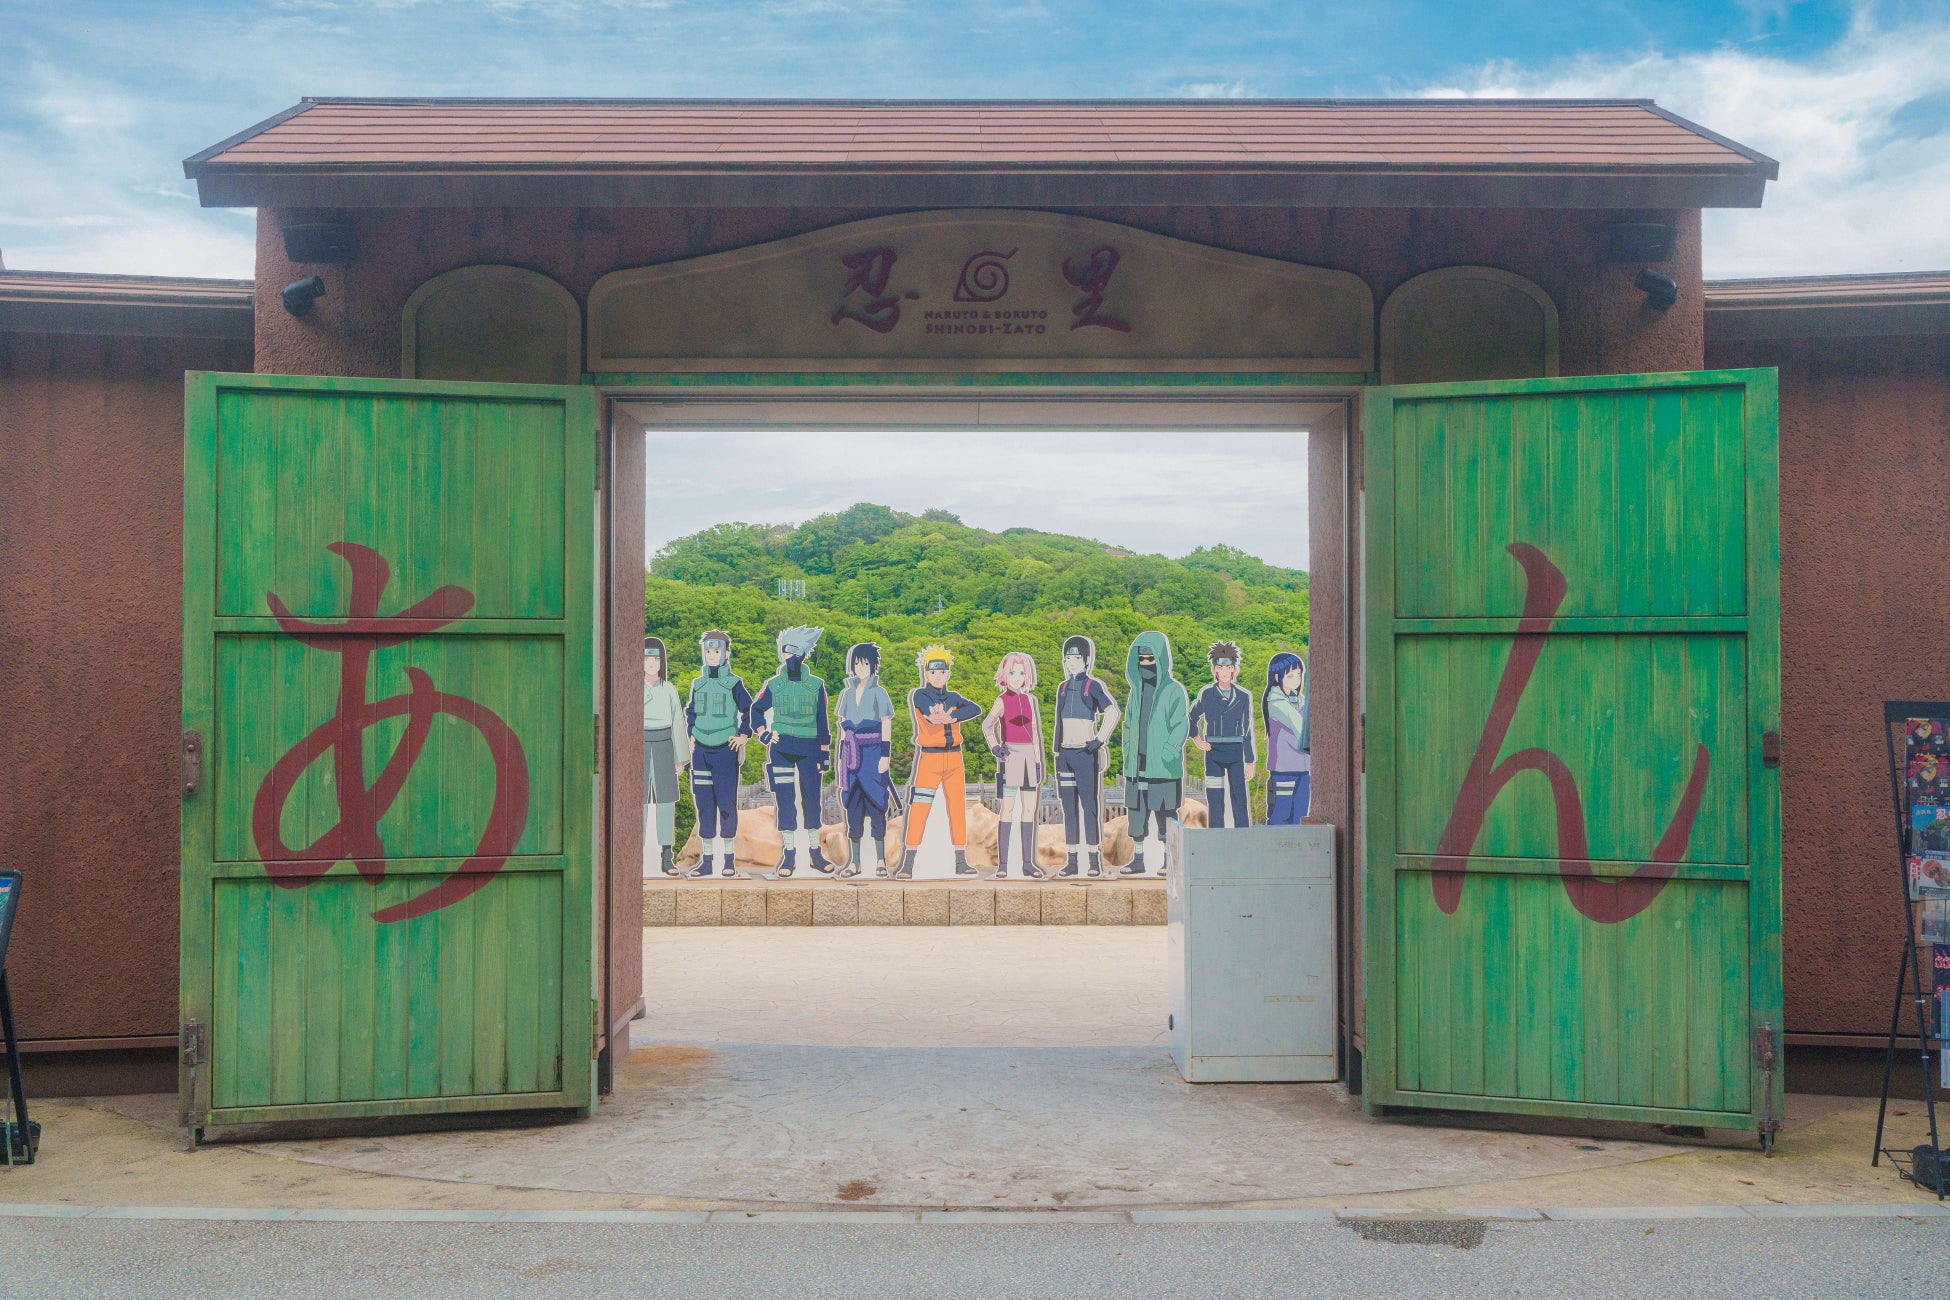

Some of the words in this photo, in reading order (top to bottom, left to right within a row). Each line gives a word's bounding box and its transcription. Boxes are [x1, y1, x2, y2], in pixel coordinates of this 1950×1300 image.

[924, 310, 979, 320] NARUTO
[982, 311, 991, 320] &
[994, 310, 1048, 320] BORUTO
[924, 323, 1047, 335] SHINOBI-ZATO
[252, 541, 530, 924] あ
[1431, 541, 1711, 924] ん
